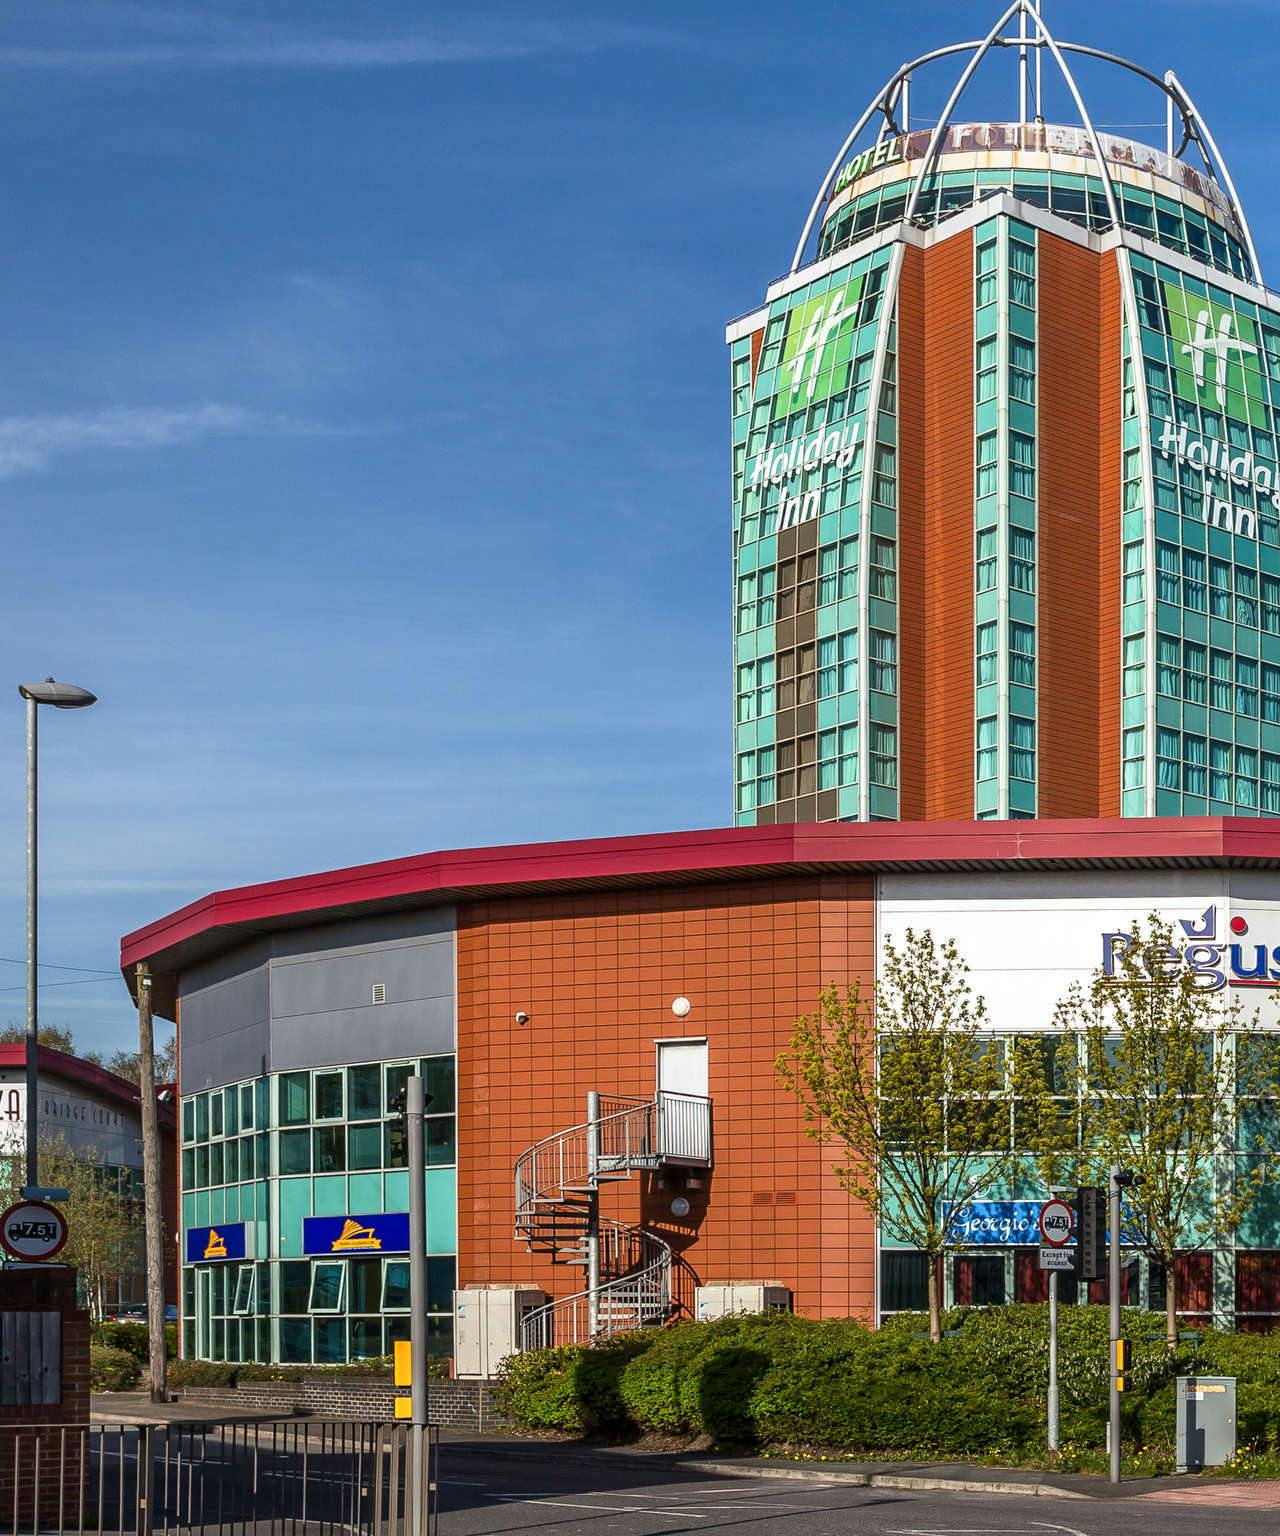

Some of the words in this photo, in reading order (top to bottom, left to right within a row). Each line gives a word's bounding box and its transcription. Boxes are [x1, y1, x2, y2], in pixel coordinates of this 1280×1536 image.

[834, 138, 901, 193] HOTEL
[750, 422, 860, 492] Holiday
[776, 486, 819, 530] Inn
[1201, 481, 1257, 538] Inn
[23, 1222, 57, 1236] 7.5T
[950, 1206, 1040, 1242] Georgio's
[1042, 1251, 1064, 1260] Except
